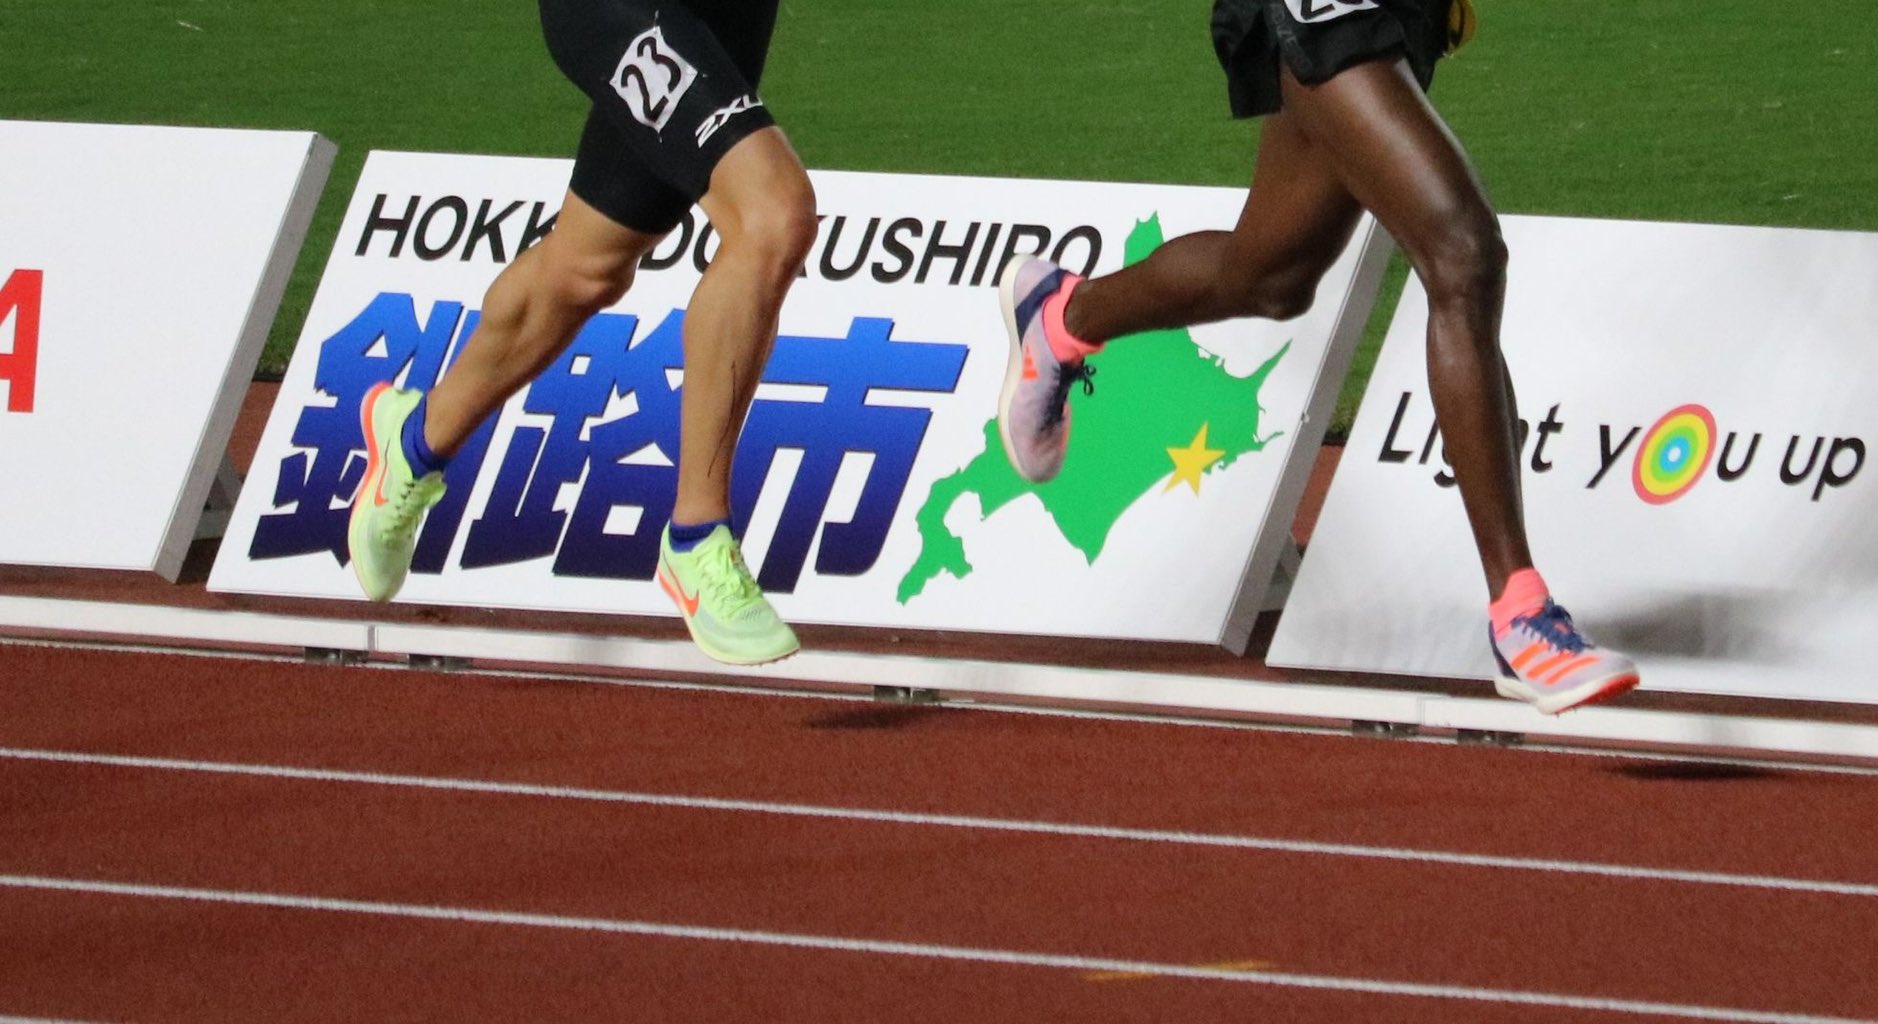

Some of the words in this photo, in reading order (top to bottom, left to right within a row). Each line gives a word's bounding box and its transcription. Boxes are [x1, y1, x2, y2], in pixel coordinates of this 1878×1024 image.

[620, 35, 682, 123] 23
[796, 214, 1103, 288] USHIRO
[1377, 391, 1565, 488] Lit
[1779, 435, 1866, 501] up
